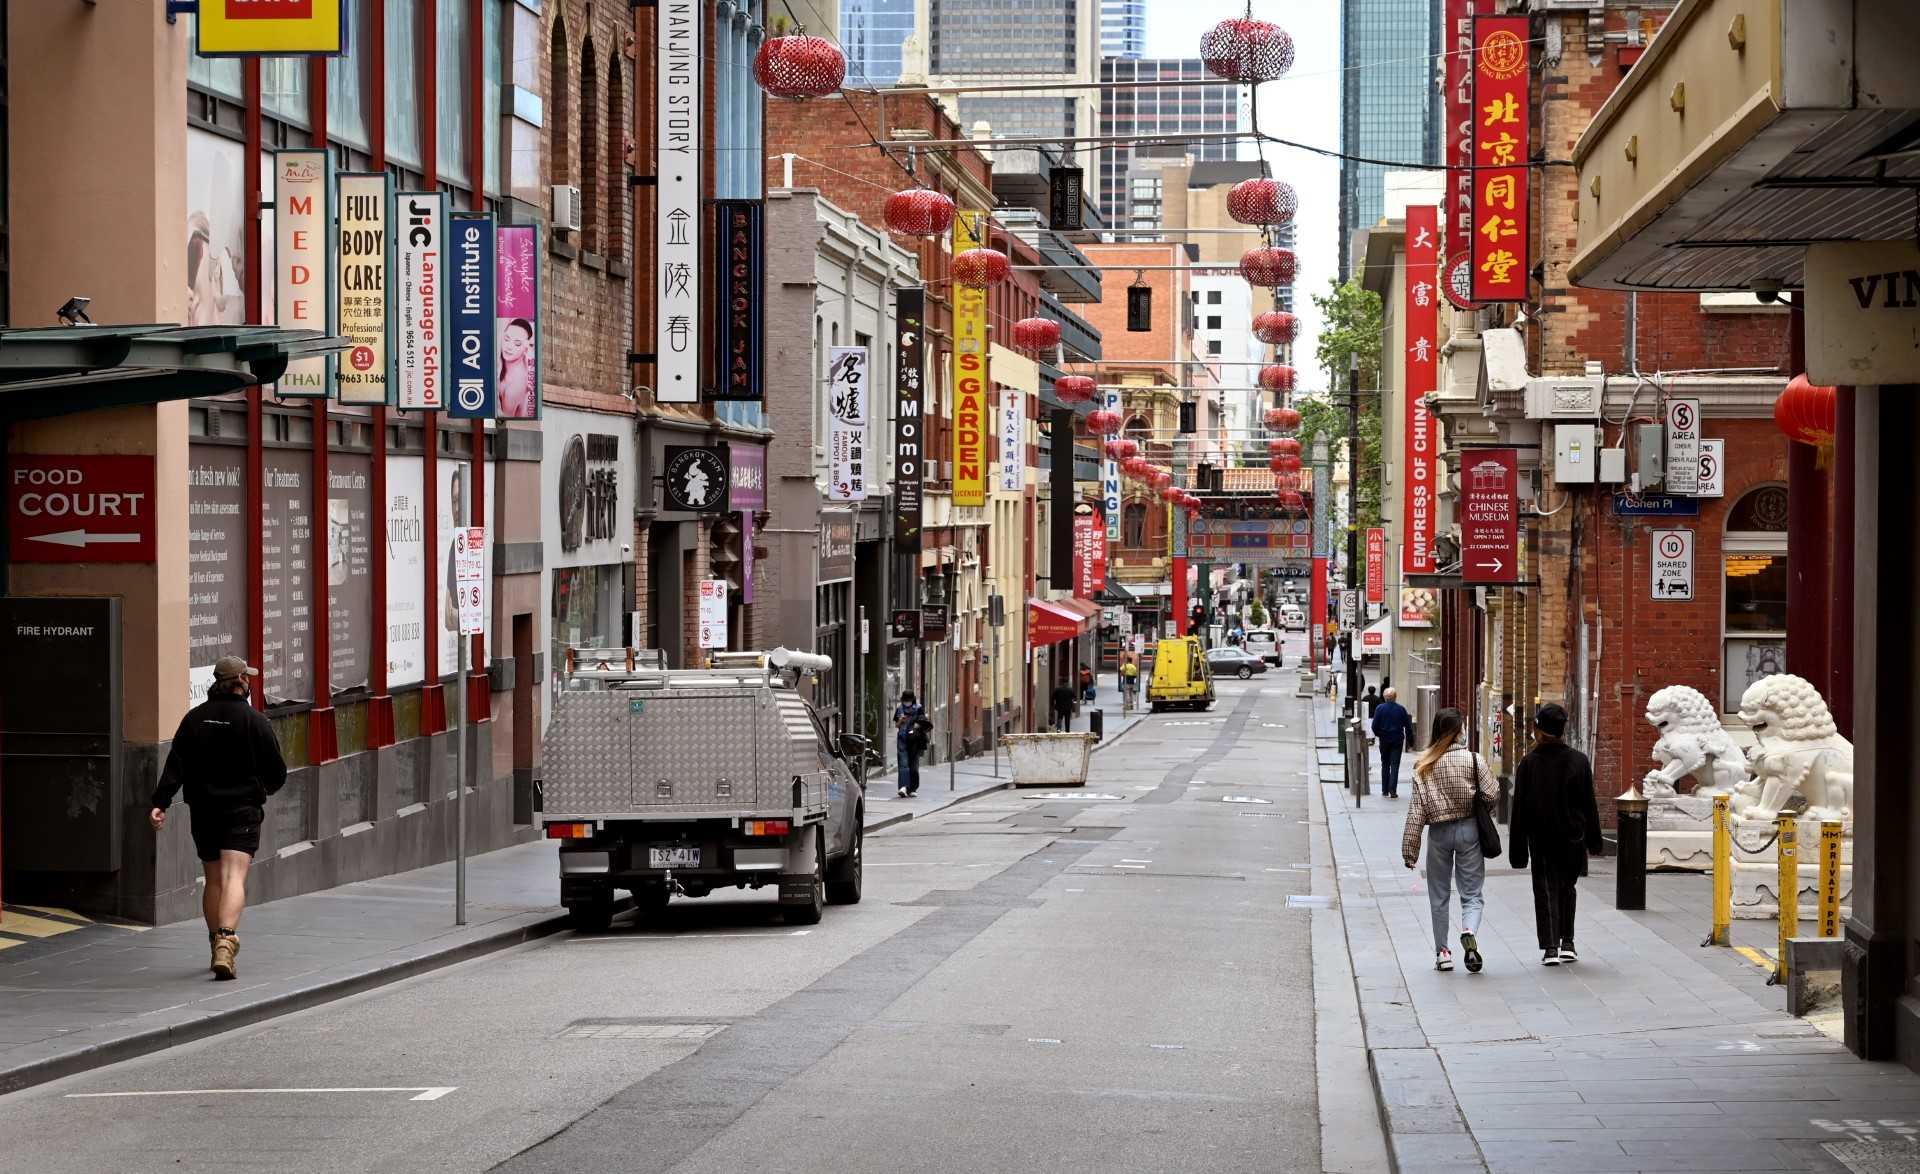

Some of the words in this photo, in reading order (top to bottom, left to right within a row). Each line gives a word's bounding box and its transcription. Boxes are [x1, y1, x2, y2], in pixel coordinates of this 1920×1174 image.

[669, 4, 689, 84] NANJING
[669, 96, 689, 153] STORY
[1481, 92, 1520, 284] 北京同仁堂
[346, 195, 380, 221] FULL
[342, 230, 383, 255] BODY
[289, 195, 313, 320] MEDE
[344, 265, 382, 290] CARE
[461, 227, 480, 314] Institute
[664, 207, 691, 353] 金陵春
[732, 214, 748, 328] BANGKOK
[419, 252, 437, 340] Language
[1409, 226, 1433, 363] 大富贵
[342, 323, 384, 333] Professional
[406, 330, 414, 348] 9654
[355, 351, 369, 361] $1
[406, 351, 414, 368] 5121
[462, 329, 480, 369] AOI
[732, 339, 748, 386] JAM
[284, 373, 321, 386] THAI
[341, 374, 362, 384] 9663
[365, 374, 385, 384] 1366
[423, 346, 439, 405] School
[959, 377, 981, 481] GARDEN
[1413, 396, 1427, 451] CHINA
[1671, 432, 1696, 440] AREA
[899, 401, 918, 475] Momo
[671, 451, 705, 473] BANGKOK
[708, 457, 721, 473] JAM
[1413, 457, 1427, 479] OF
[14, 469, 83, 485] FOOD
[200, 465, 214, 486] fresh
[214, 469, 226, 487] new
[227, 466, 241, 488] look?
[264, 467, 274, 487] Our
[274, 467, 300, 488] Treatments
[352, 470, 366, 489] Centre
[18, 493, 145, 516] COURT
[1469, 502, 1509, 512] CHINESE
[1625, 499, 1660, 508] Cohen
[1663, 499, 1673, 508] Pl
[1413, 482, 1427, 568] EMPRESS
[1470, 513, 1509, 521] MUSEUM
[1667, 542, 1678, 552] 10
[1662, 569, 1682, 577] ZONE
[17, 626, 41, 636] FIRE
[43, 626, 95, 636] HYDRANT
[1828, 843, 1837, 903] PRIVATE
[1826, 911, 1834, 936] PRO
